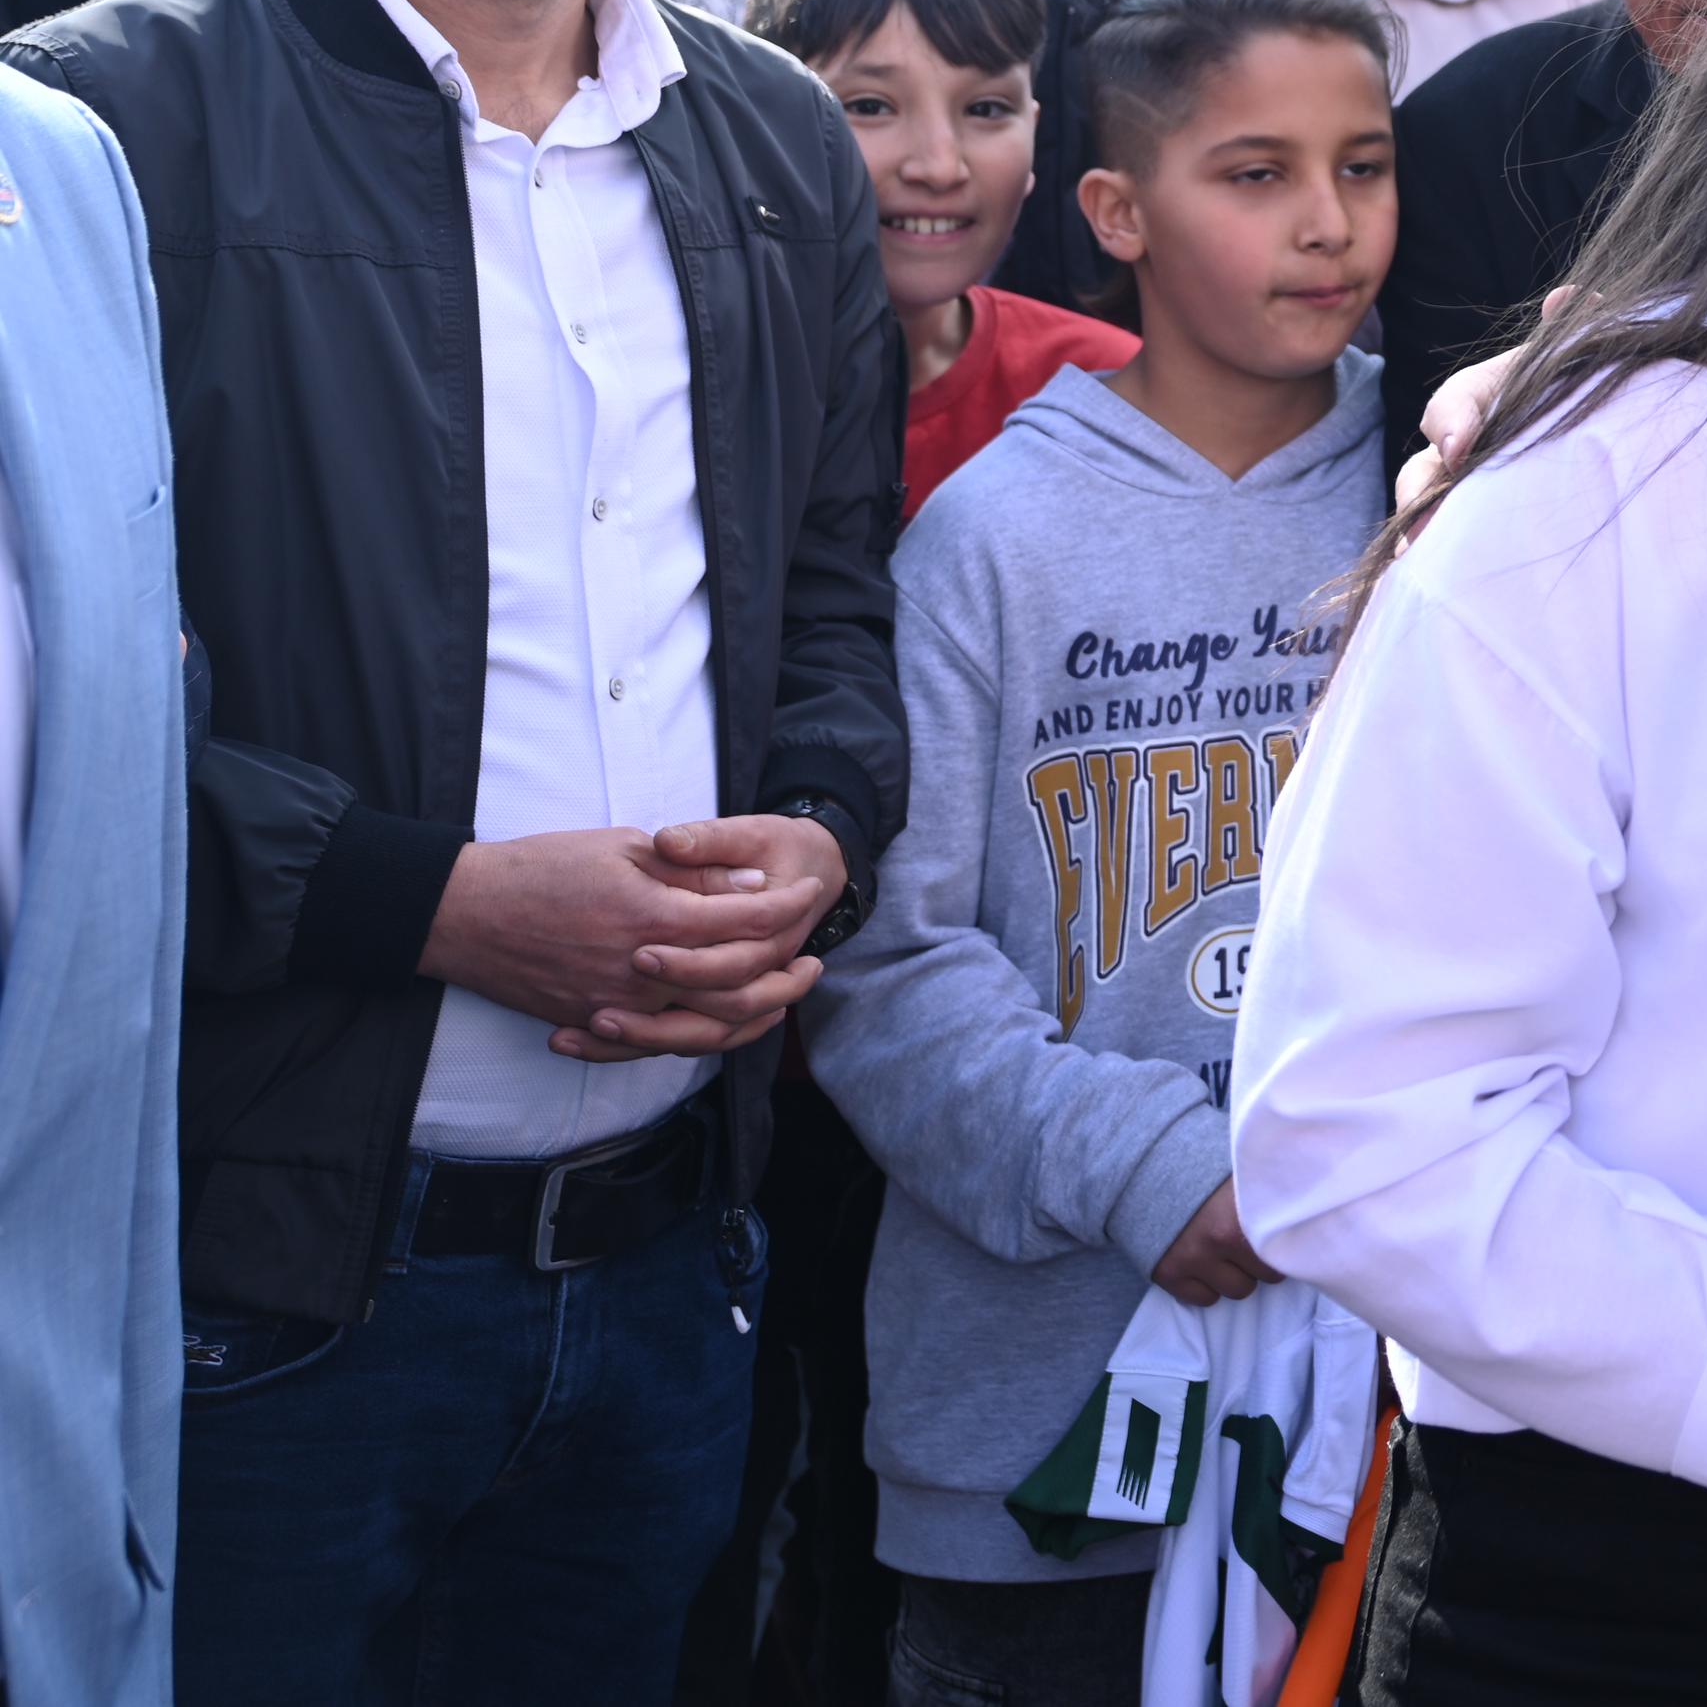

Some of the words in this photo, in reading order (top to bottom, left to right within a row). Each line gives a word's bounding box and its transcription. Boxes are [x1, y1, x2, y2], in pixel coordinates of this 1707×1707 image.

[1066, 631, 1239, 692] Change
[1034, 704, 1094, 748] AND
[1105, 692, 1203, 732] ENJOY
[1216, 682, 1294, 719] YOUR
